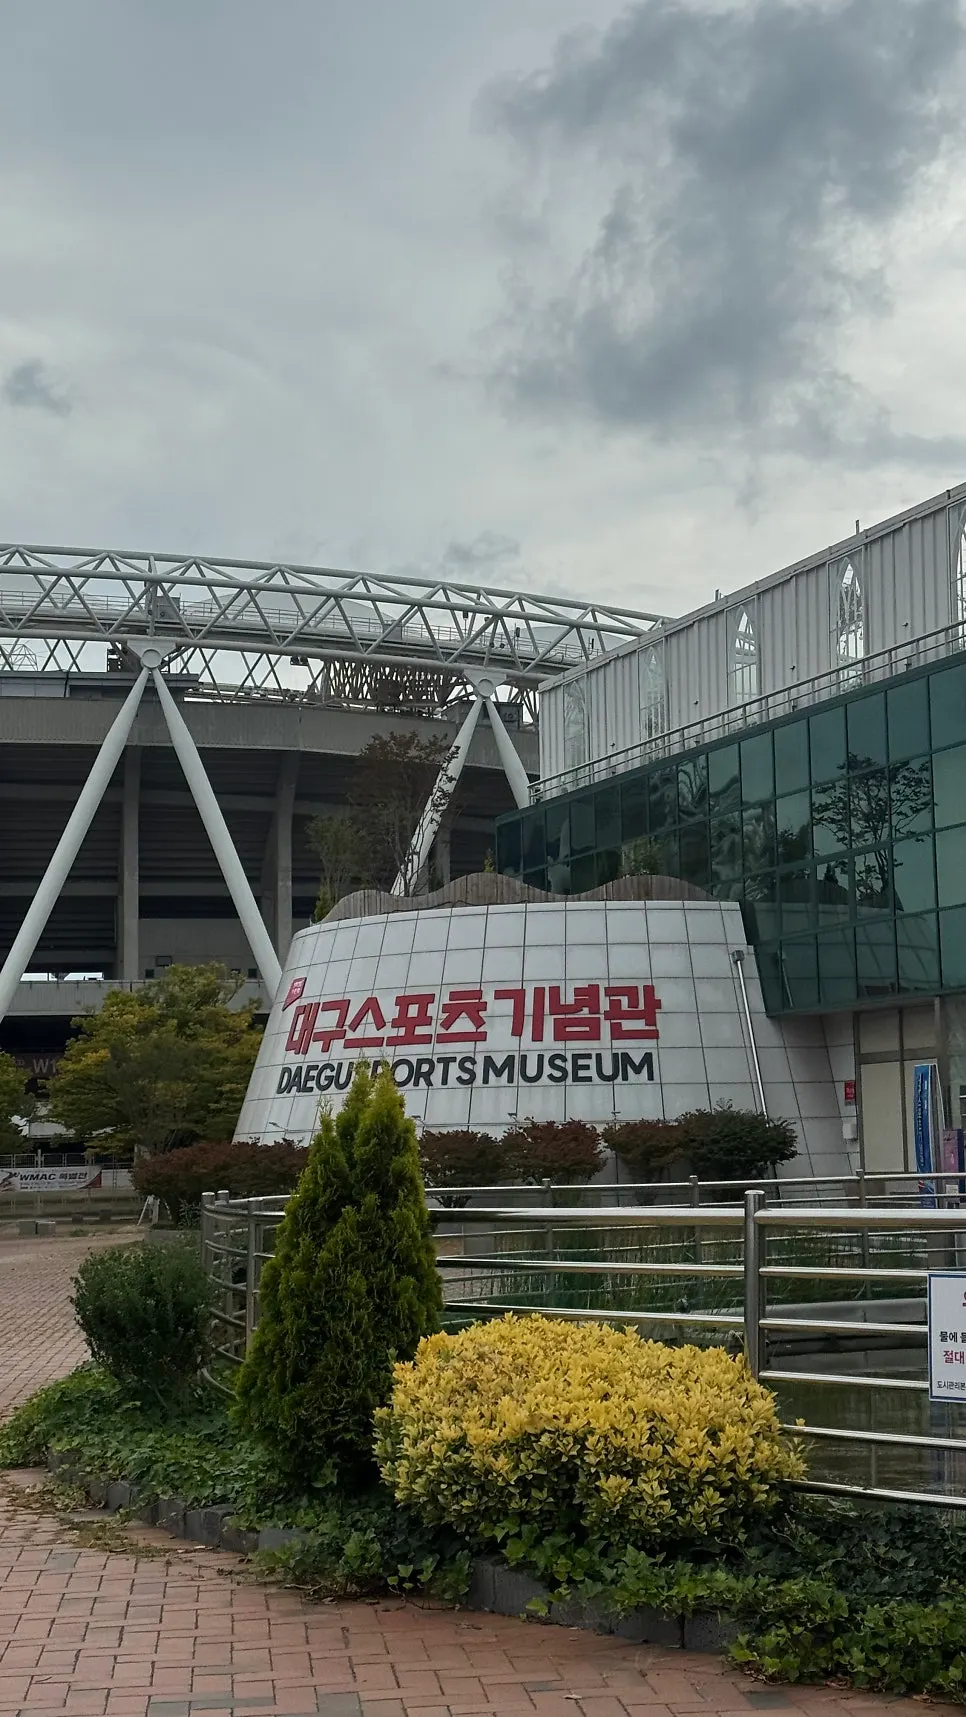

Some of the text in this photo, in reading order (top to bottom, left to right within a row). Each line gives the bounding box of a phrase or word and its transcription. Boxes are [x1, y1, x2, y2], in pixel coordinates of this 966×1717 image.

[285, 984, 662, 1055] 대구스포츠기념관
[276, 1052, 655, 1094] DAEGU ORTS MUSEUM
[20, 1173, 57, 1181] WMAC
[939, 1331, 958, 1343] 물에
[943, 1350, 965, 1365] 절대
[936, 1380, 966, 1391] 도시관리본
